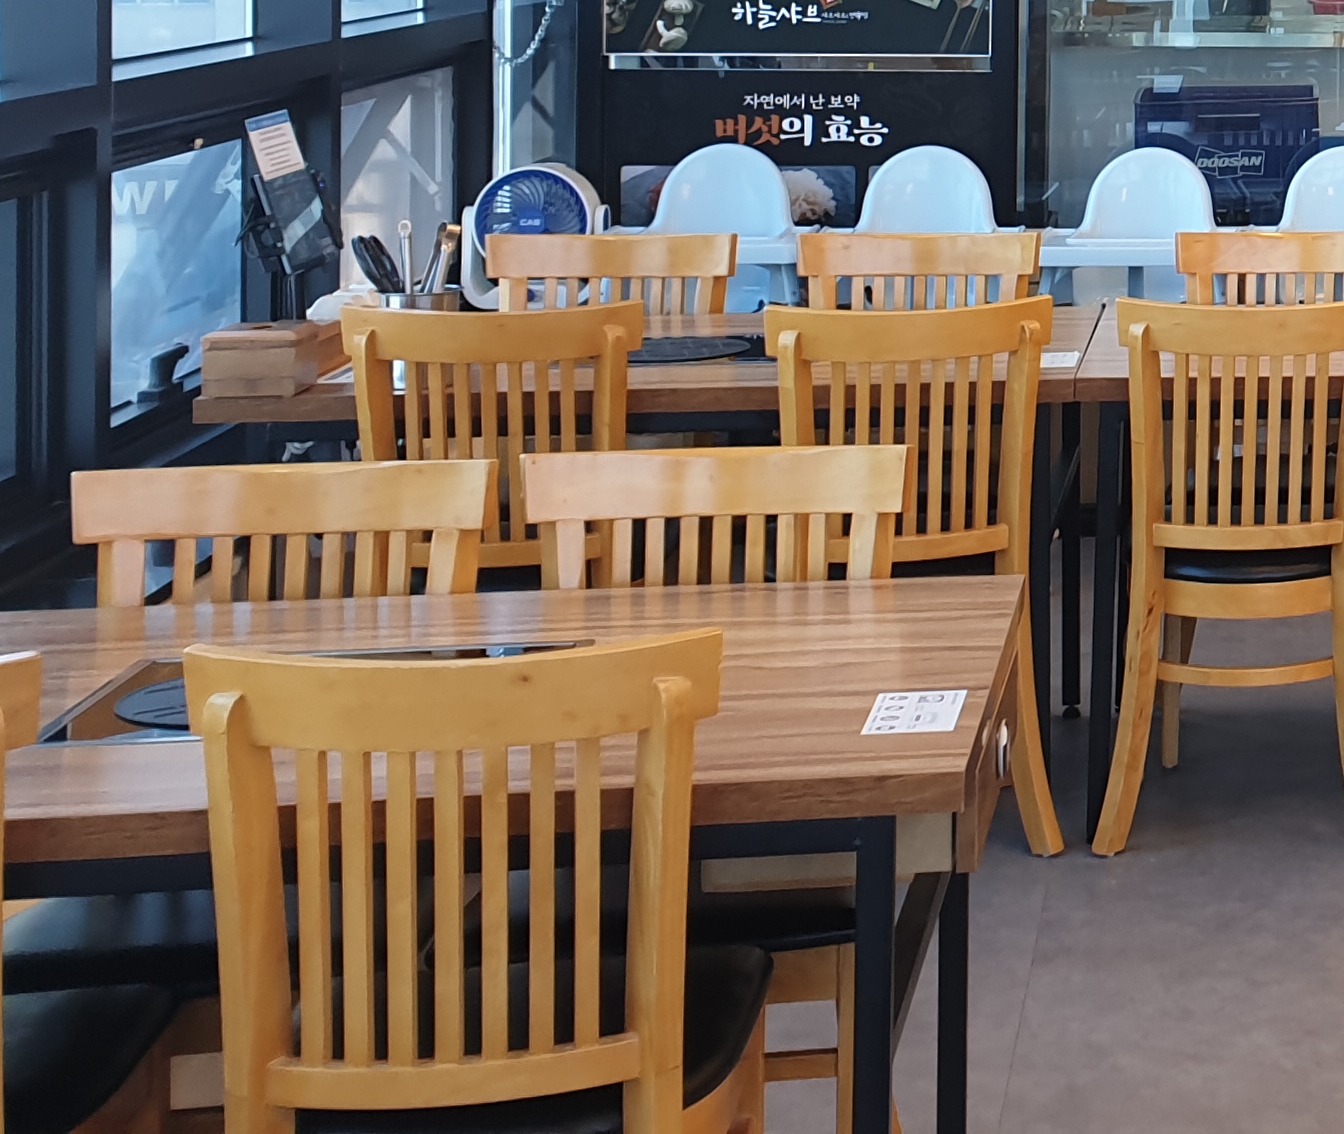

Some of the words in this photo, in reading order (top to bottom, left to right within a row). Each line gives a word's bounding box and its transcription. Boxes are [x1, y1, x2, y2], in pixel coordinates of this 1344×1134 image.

[743, 93, 806, 110] 자연에서
[810, 94, 825, 110] 난
[828, 94, 861, 110] 보약
[714, 113, 813, 146] 버섯의
[821, 114, 890, 147] 효능
